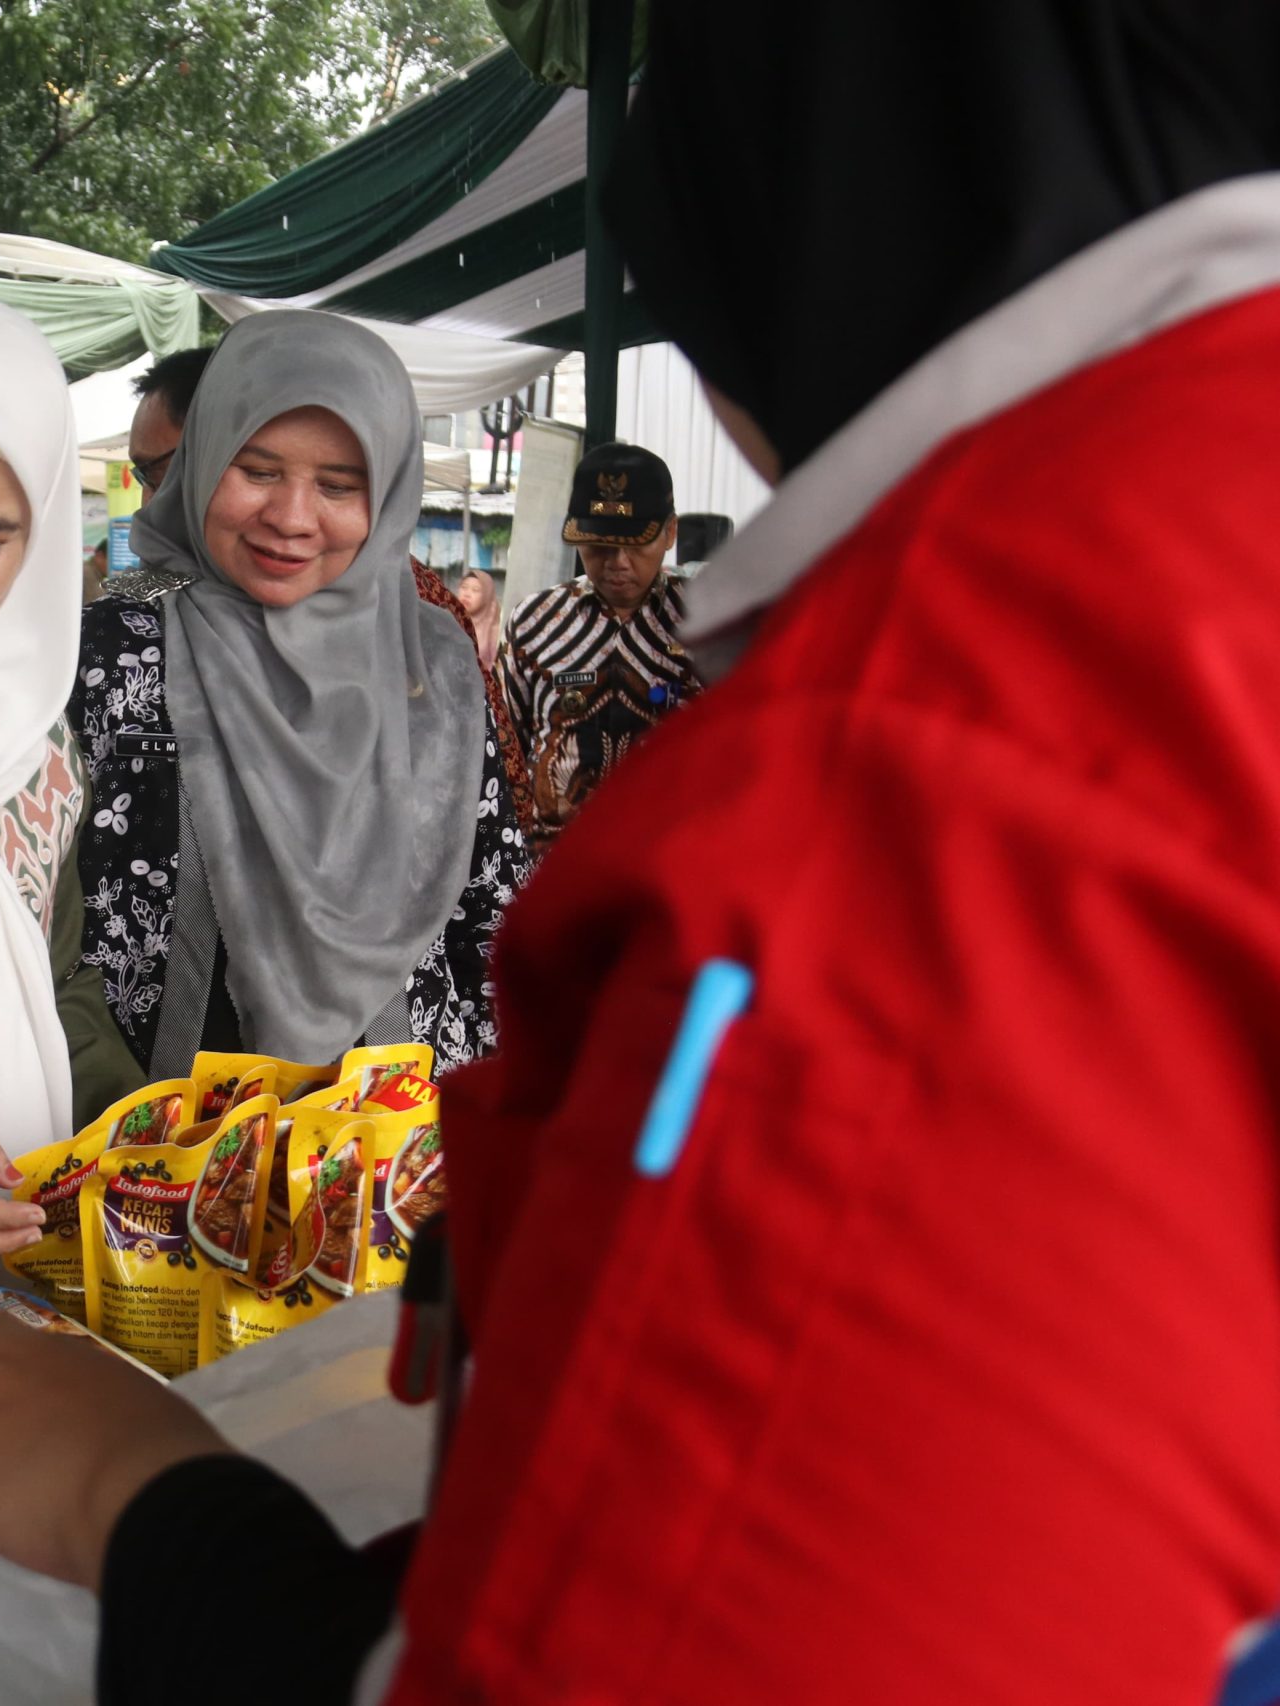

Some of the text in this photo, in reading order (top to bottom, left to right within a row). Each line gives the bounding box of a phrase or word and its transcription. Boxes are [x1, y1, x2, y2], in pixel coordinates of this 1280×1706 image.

[39, 1163, 98, 1204] Indofood
[115, 1176, 189, 1199] Indofood
[121, 1197, 174, 1217] KECAP
[120, 1212, 173, 1235] MANIS
[120, 1282, 159, 1294] Indofood
